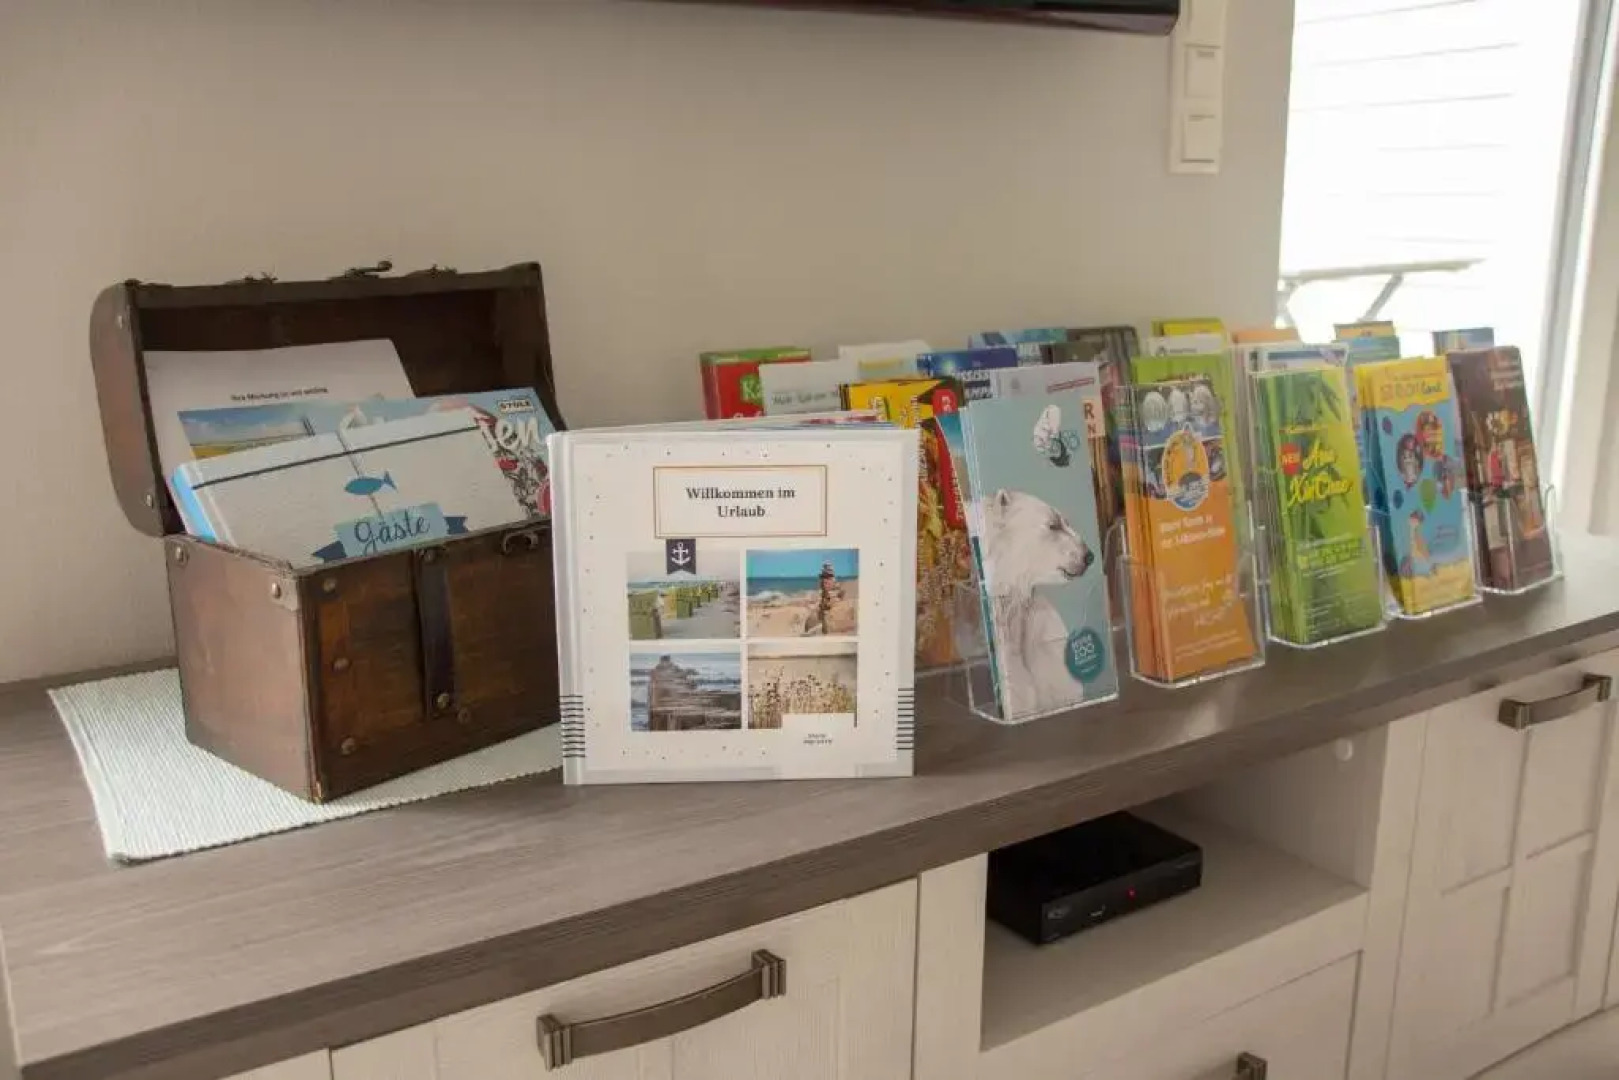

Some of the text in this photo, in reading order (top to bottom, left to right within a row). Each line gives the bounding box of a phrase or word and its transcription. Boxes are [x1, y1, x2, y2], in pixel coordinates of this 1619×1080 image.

[685, 486, 796, 500] Willkommen im
[716, 505, 766, 518] Urlaub
[354, 508, 431, 556] Gäste
